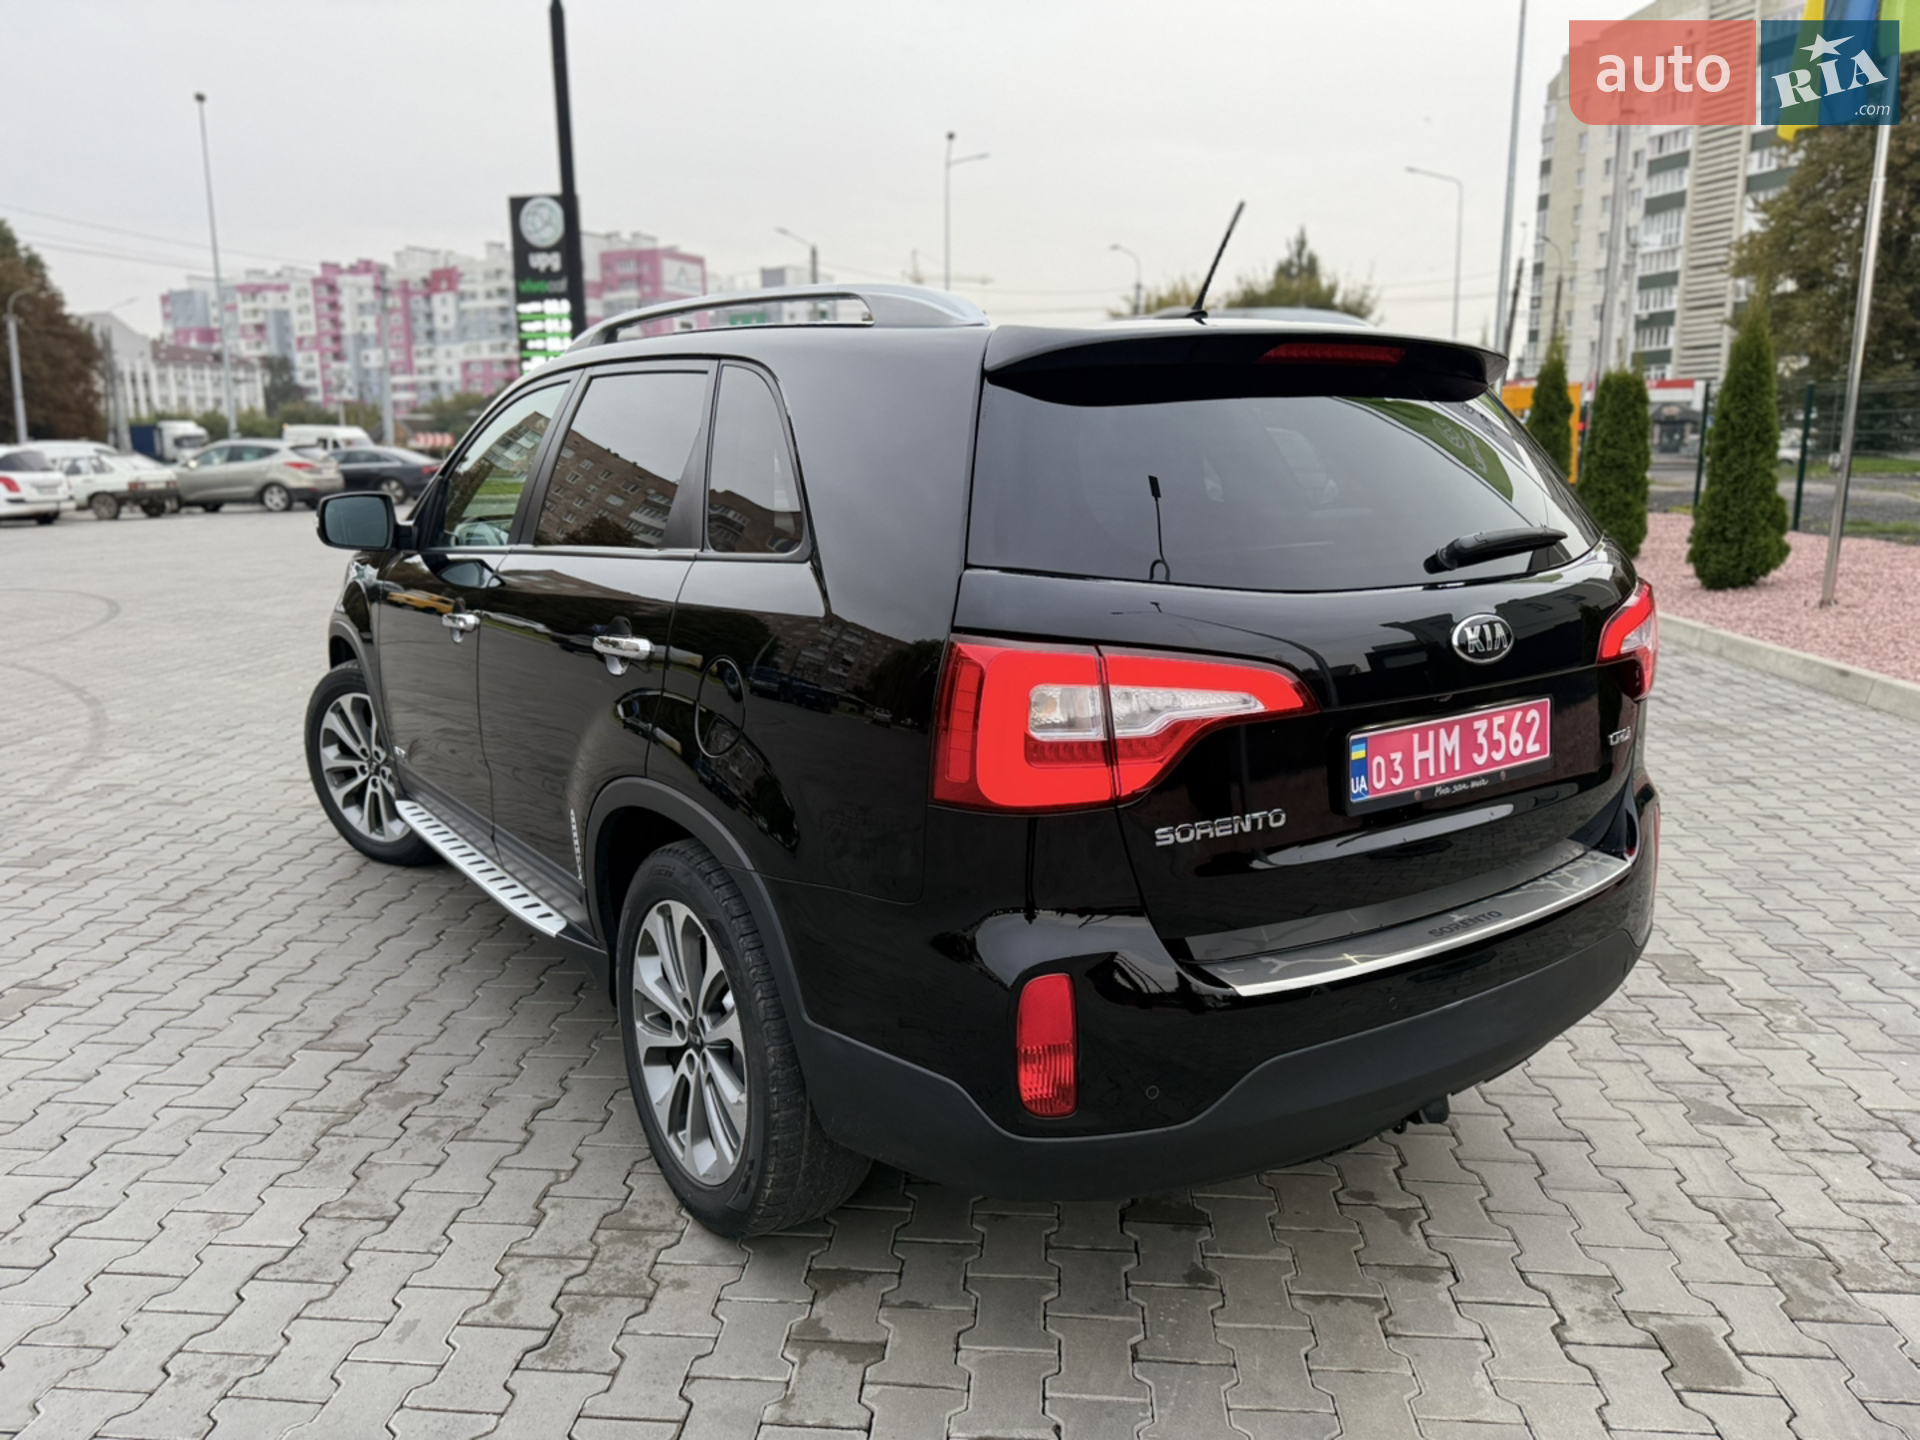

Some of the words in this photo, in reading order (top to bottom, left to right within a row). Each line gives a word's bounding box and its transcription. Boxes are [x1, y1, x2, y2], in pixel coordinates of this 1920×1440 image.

[1464, 623, 1508, 653] KIA
[1371, 752, 1404, 790] 03
[1412, 724, 1461, 780] HM
[1471, 708, 1541, 766] 3562
[1351, 775, 1368, 794] UA
[1155, 808, 1287, 847] SORENTO
[1428, 910, 1503, 937] SORENTO
